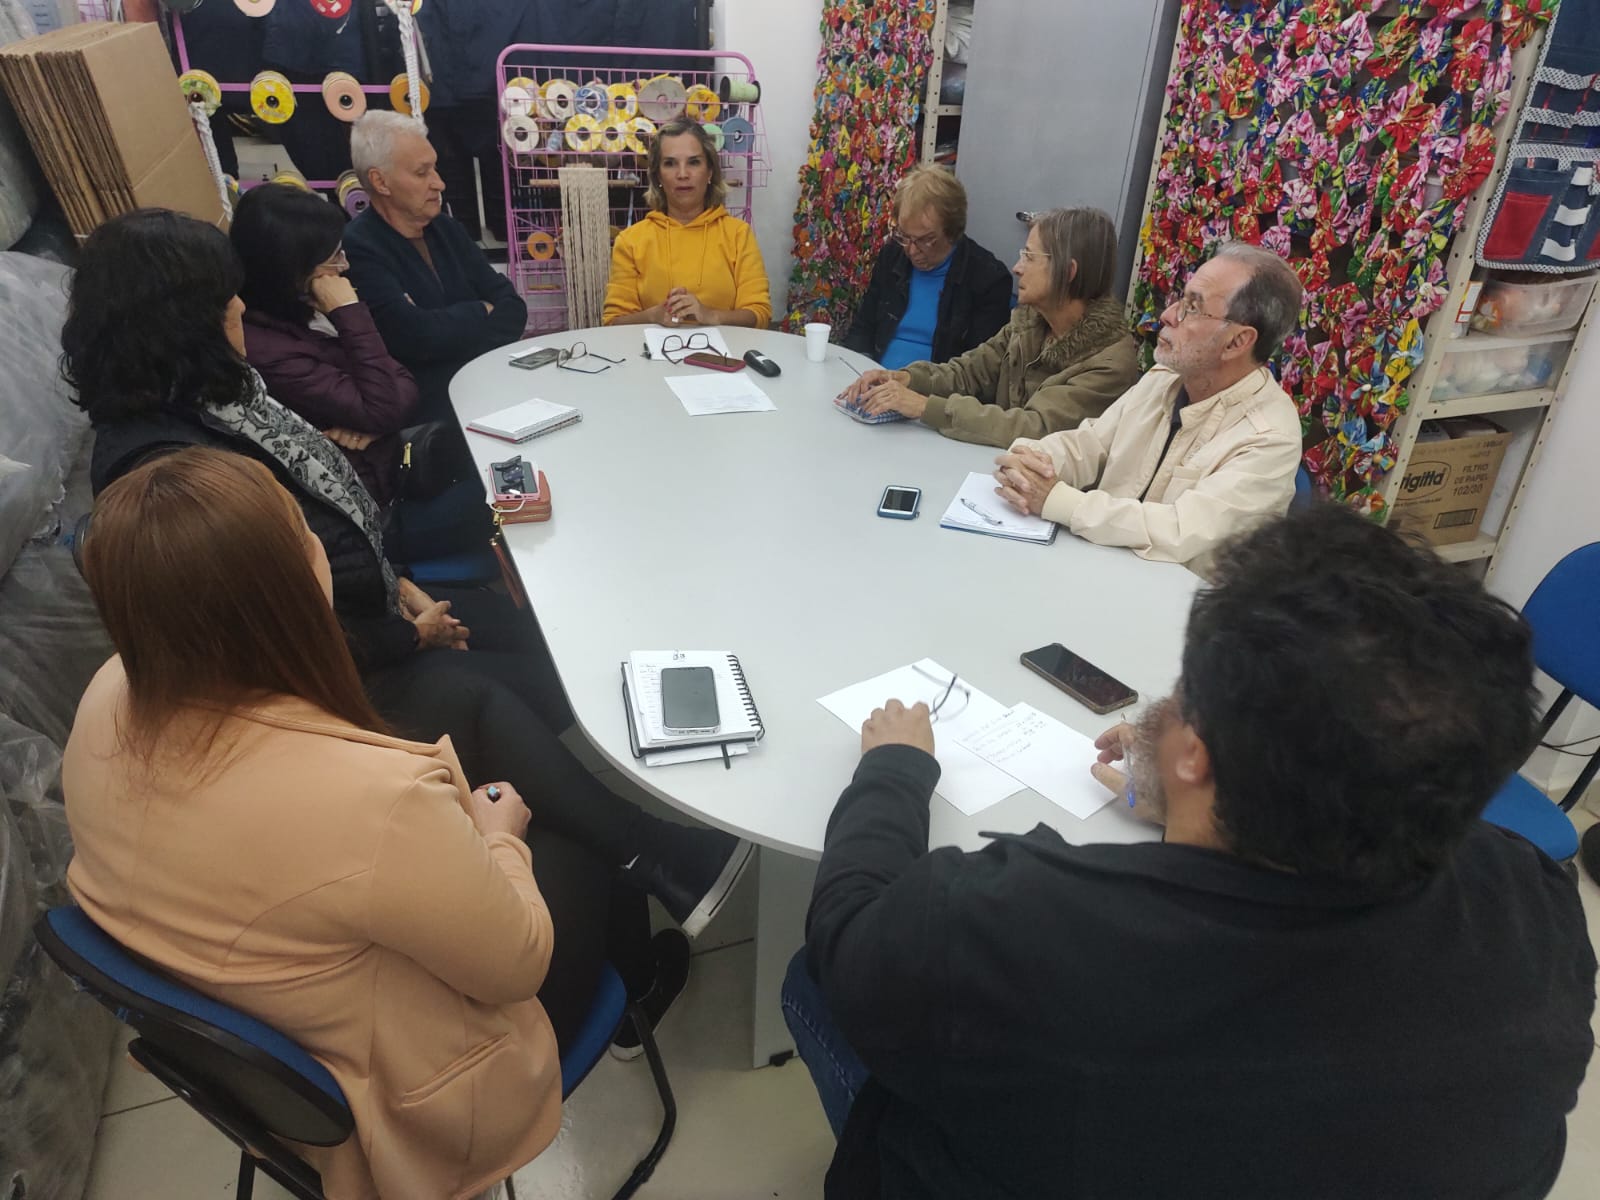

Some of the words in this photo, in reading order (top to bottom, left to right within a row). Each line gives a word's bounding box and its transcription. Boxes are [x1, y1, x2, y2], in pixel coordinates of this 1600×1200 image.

[1462, 463, 1489, 473] FILTRO
[1399, 470, 1445, 493] rigitta
[1465, 473, 1489, 483] PAPEL
